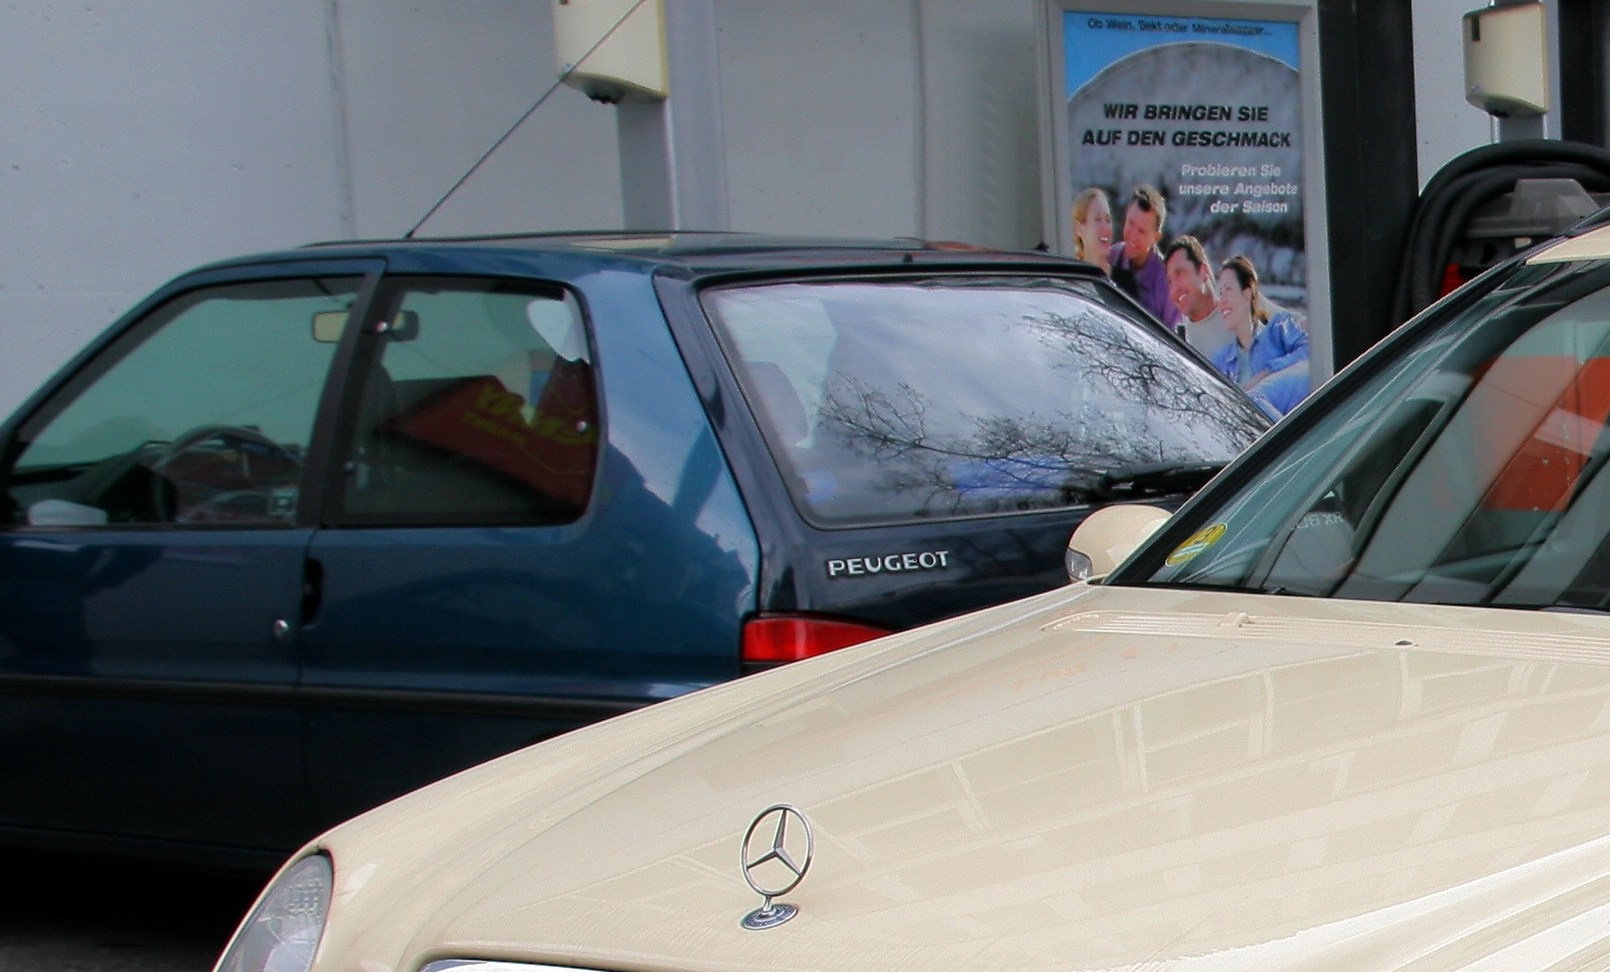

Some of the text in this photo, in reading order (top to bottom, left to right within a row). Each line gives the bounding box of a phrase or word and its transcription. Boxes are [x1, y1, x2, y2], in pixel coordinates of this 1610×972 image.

[1104, 103, 1268, 121] WIR BRINGEN SIE
[1082, 129, 1291, 147] AUF DEN GESCHMACK
[1181, 164, 1281, 177] Probieren Sie
[1179, 183, 1298, 198] unsere Angebote
[1210, 201, 1288, 213] der Saison
[828, 551, 949, 576] PEUGEOT
